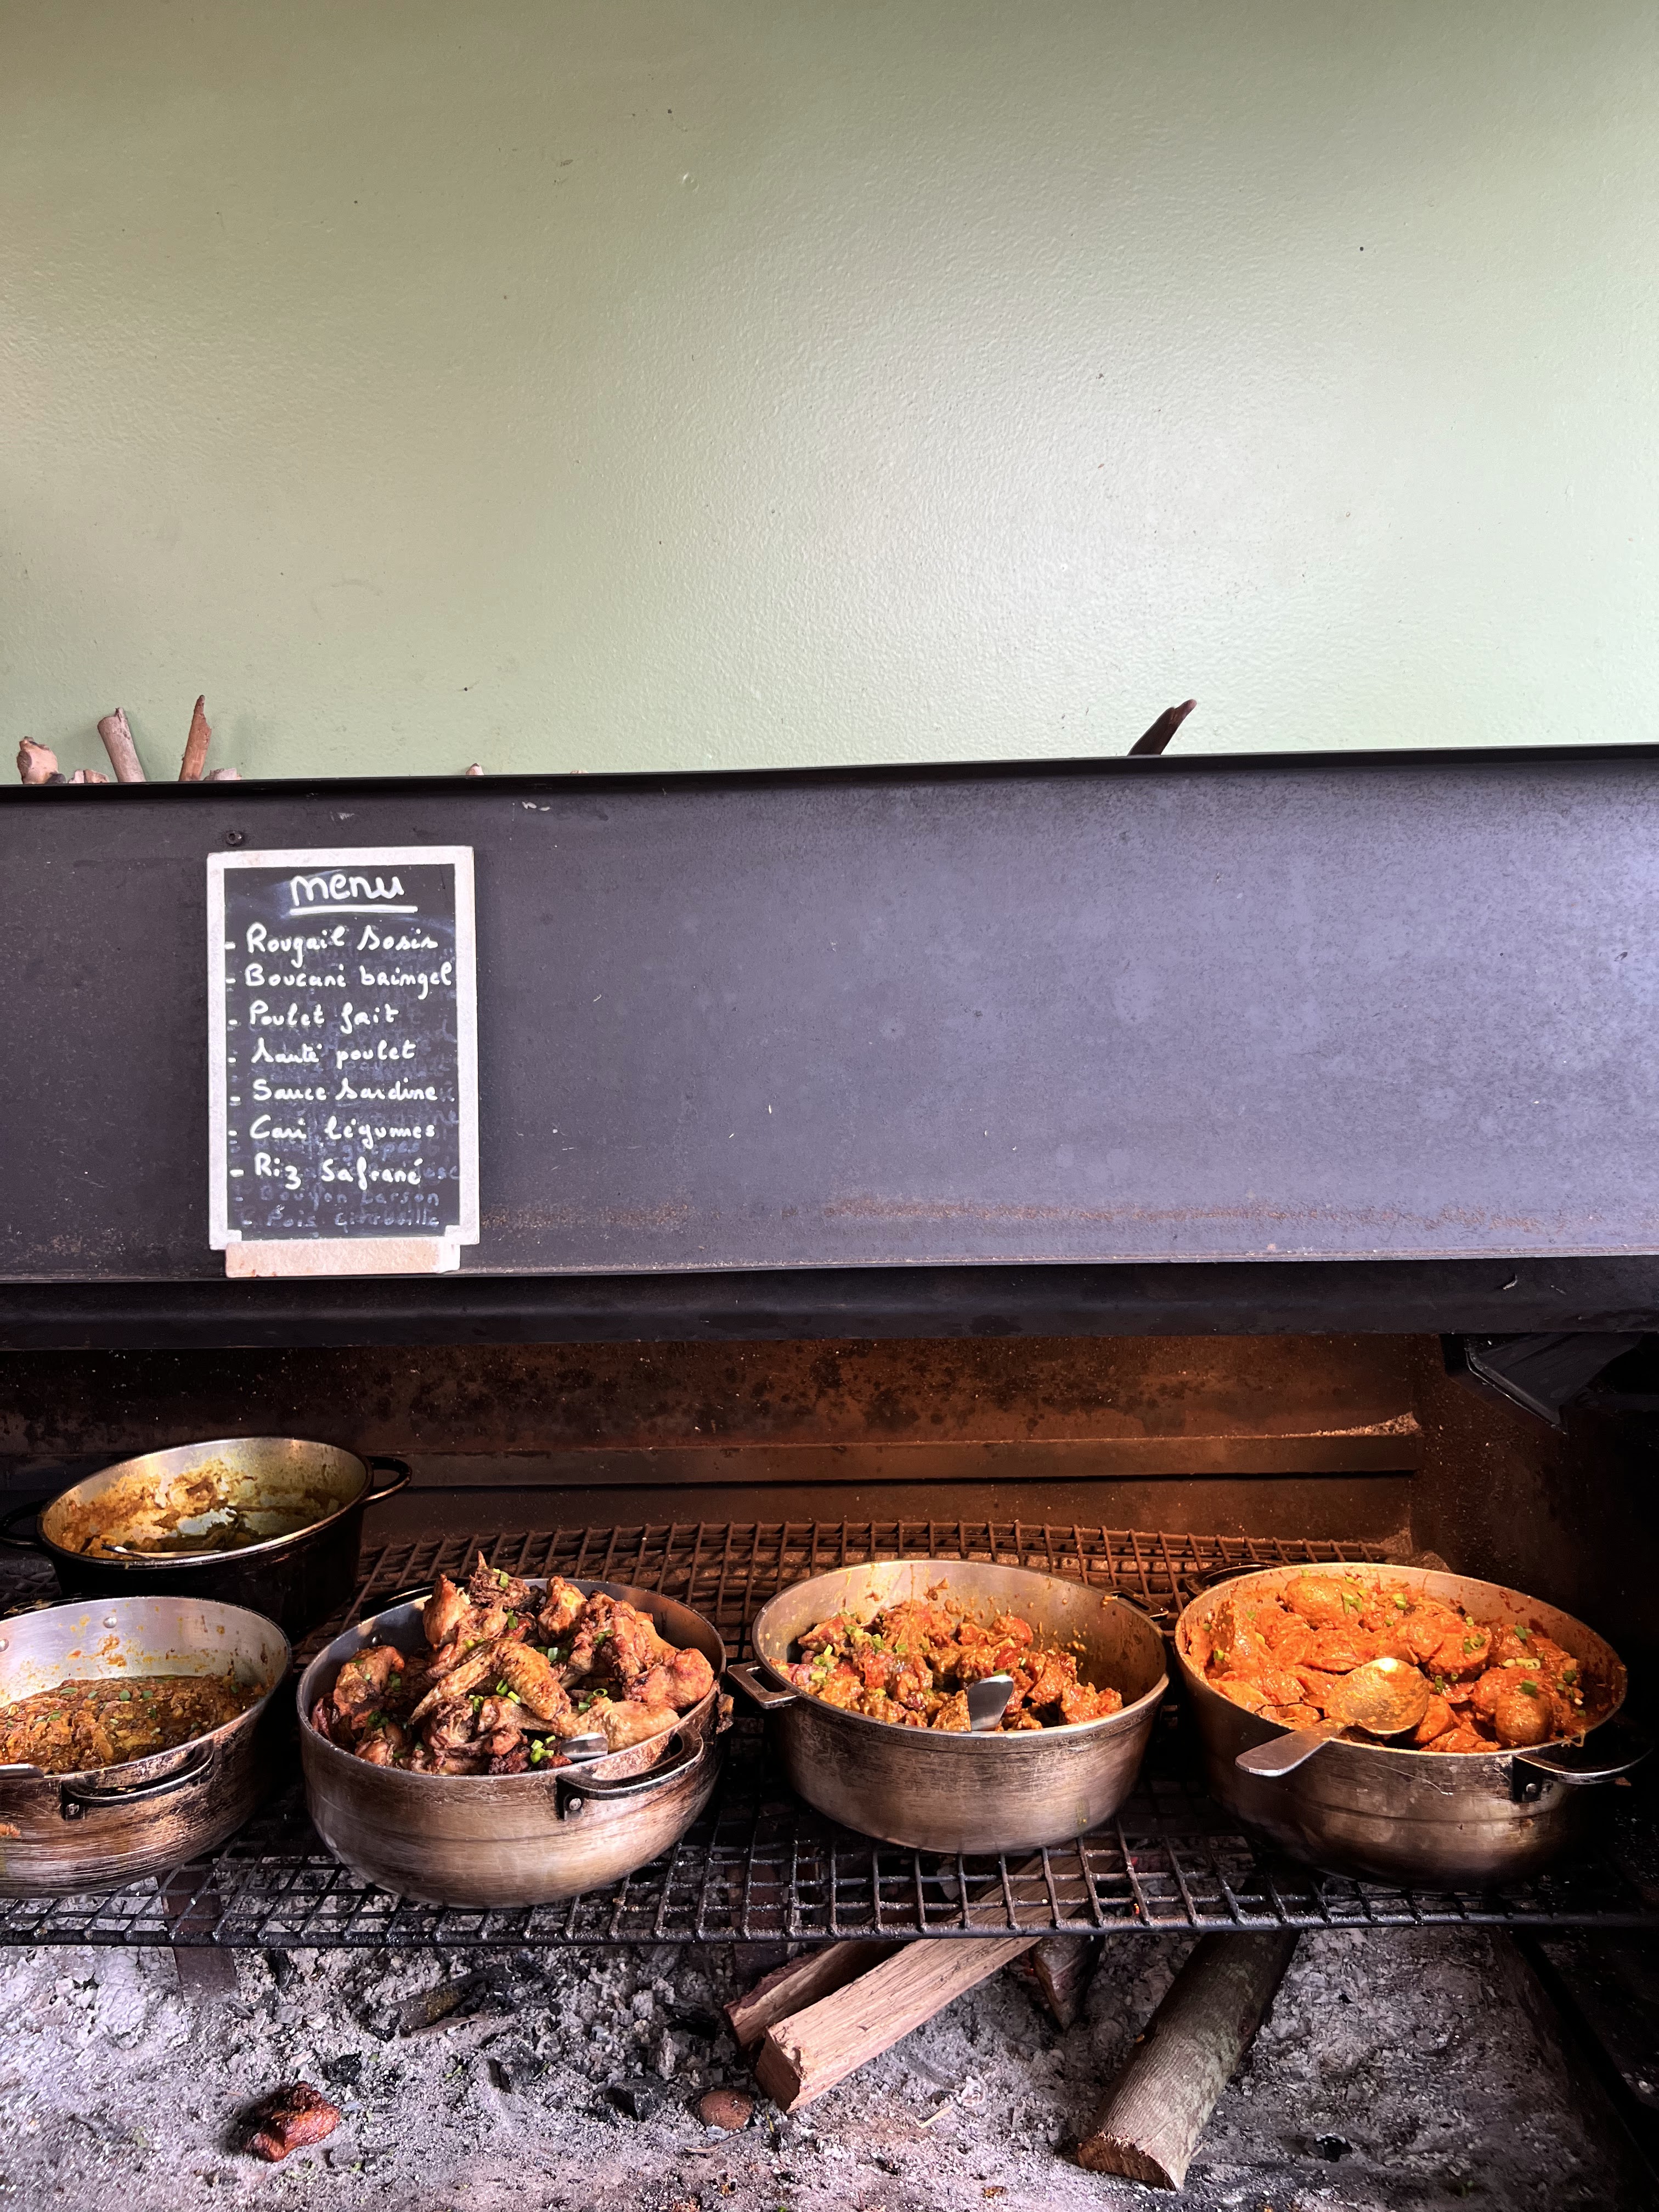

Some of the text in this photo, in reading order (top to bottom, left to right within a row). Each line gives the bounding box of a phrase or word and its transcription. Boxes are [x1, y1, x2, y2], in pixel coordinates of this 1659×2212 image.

[246, 921, 346, 968] Rougail
[249, 1000, 400, 1035] Poulet fait
[335, 1039, 417, 1070] poulet
[252, 1077, 328, 1102] Sauce
[253, 1151, 302, 1190] Riz
